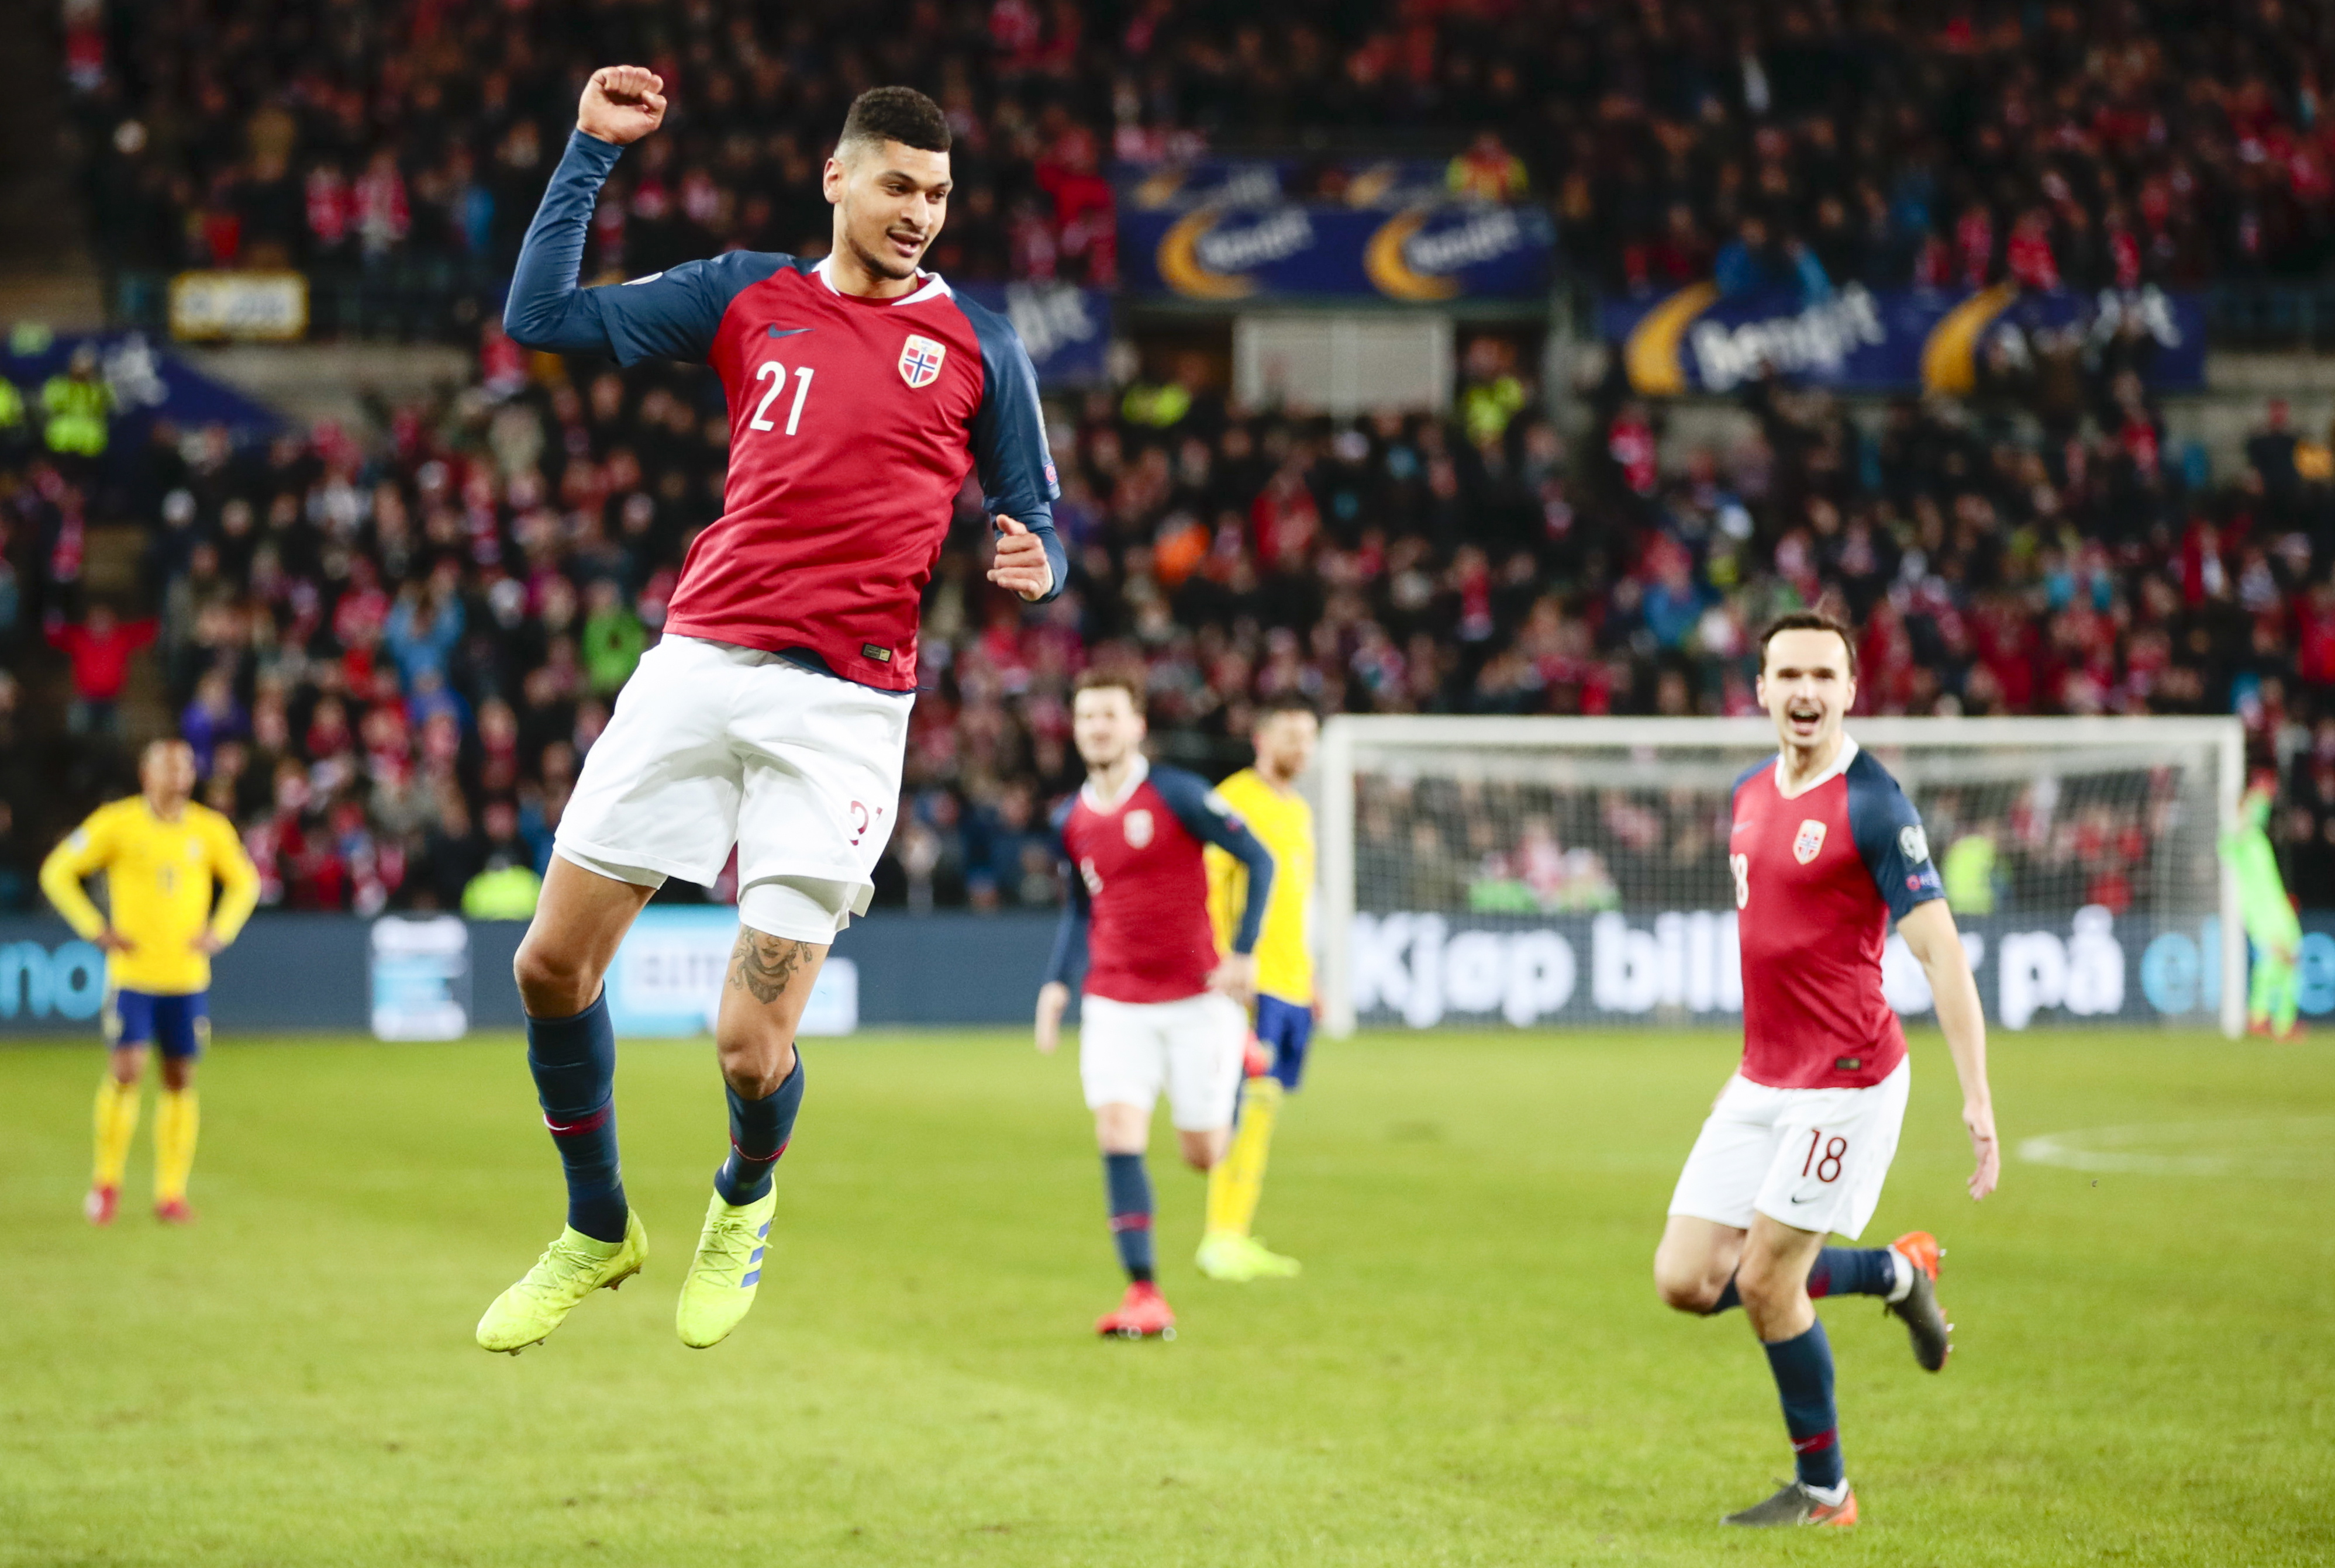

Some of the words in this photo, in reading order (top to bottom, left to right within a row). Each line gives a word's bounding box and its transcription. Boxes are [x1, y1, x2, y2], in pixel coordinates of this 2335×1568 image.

[749, 361, 815, 436] 21
[1999, 906, 2125, 1030] på
[1802, 1128, 1847, 1183] 18
